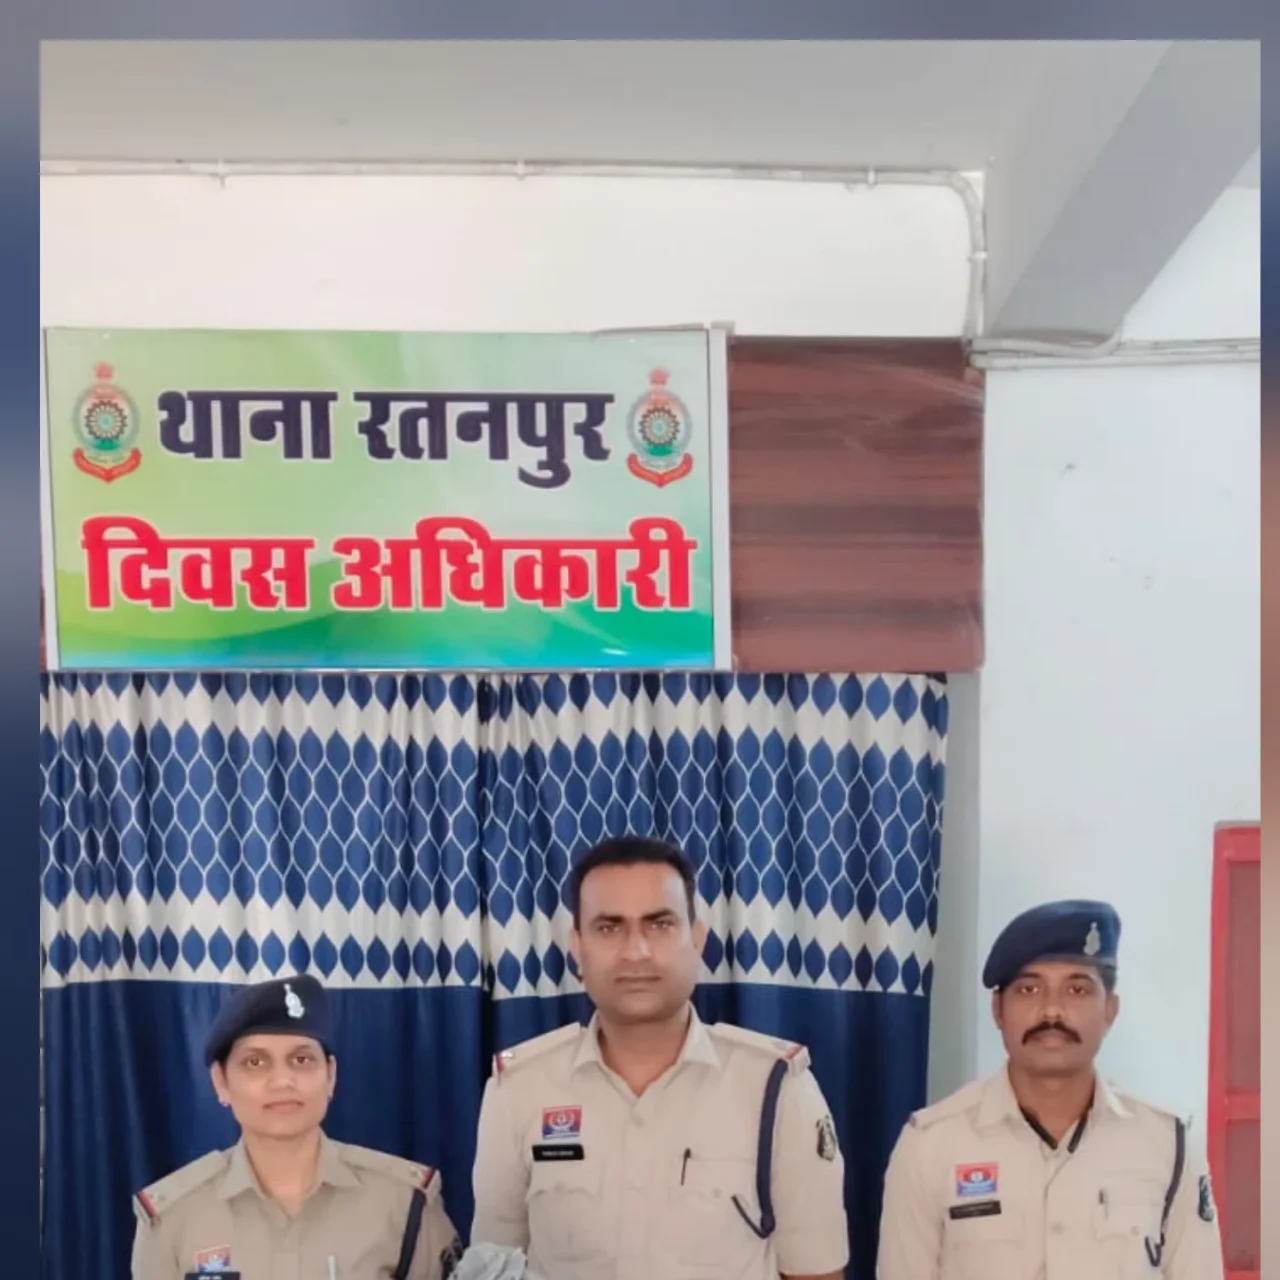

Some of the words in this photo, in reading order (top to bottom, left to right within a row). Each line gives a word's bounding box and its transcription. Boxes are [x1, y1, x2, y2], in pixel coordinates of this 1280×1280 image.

[158, 390, 338, 461] थाना
[353, 392, 615, 489] रतनपुर
[81, 516, 315, 610] दिवस
[331, 516, 699, 611] अधिकारी
